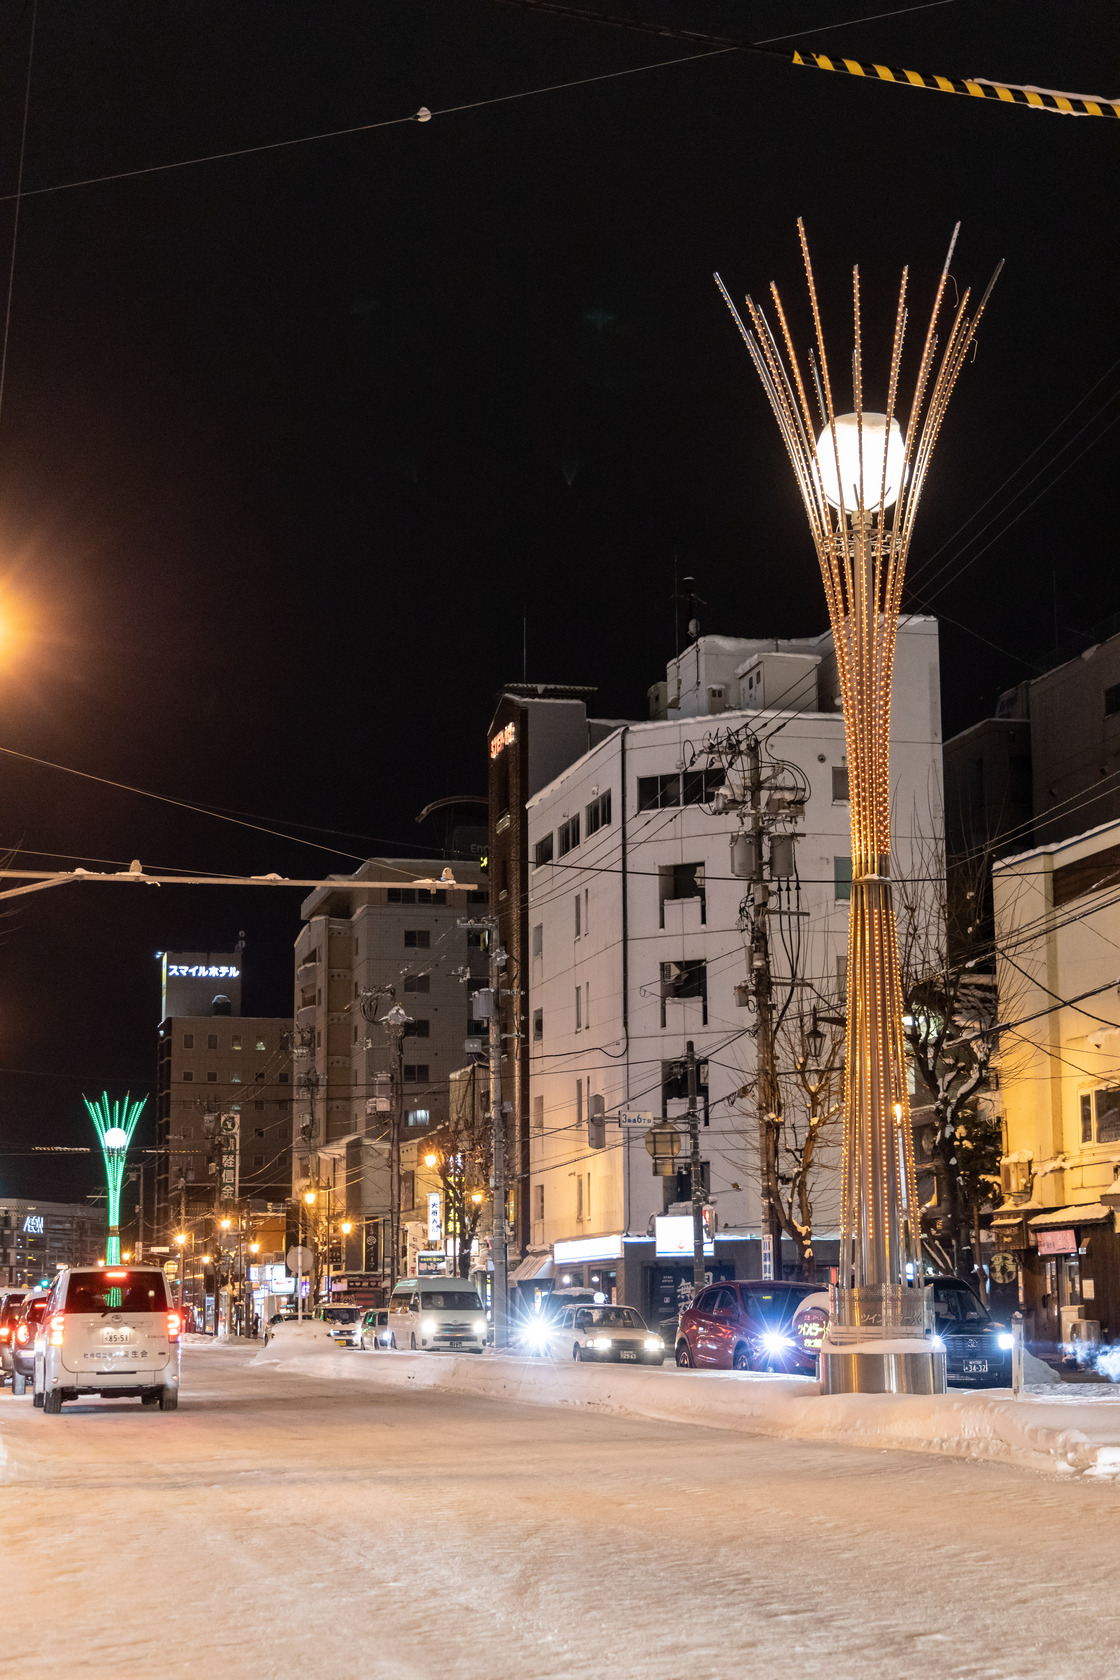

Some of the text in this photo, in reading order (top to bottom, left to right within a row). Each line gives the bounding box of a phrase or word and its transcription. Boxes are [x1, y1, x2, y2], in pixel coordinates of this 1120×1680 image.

[168, 965, 240, 977] スマイルホテル
